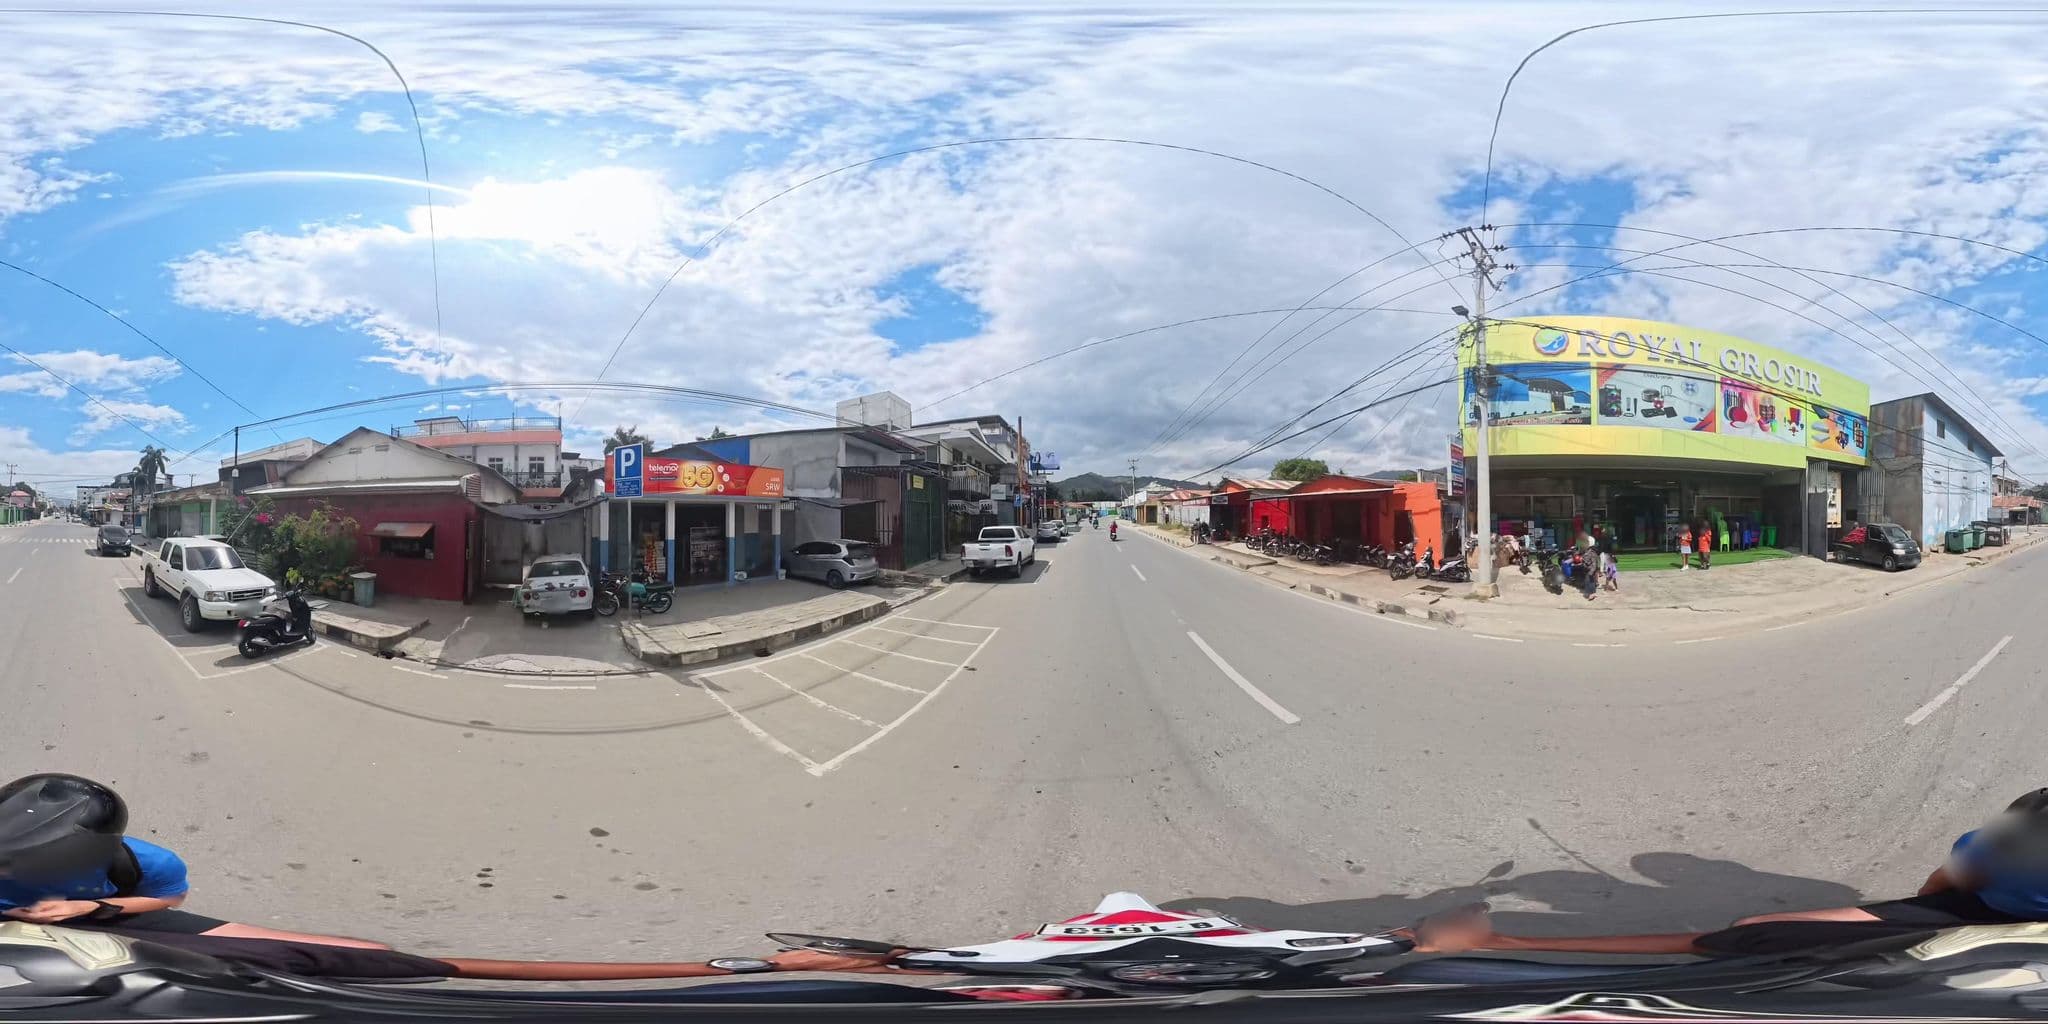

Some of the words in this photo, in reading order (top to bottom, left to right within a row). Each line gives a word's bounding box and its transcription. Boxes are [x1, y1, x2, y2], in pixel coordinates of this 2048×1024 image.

[1577, 329, 1709, 367] ROYAL
[1720, 348, 1822, 396] GROSIR
[620, 448, 635, 477] P
[682, 464, 714, 488] 5G
